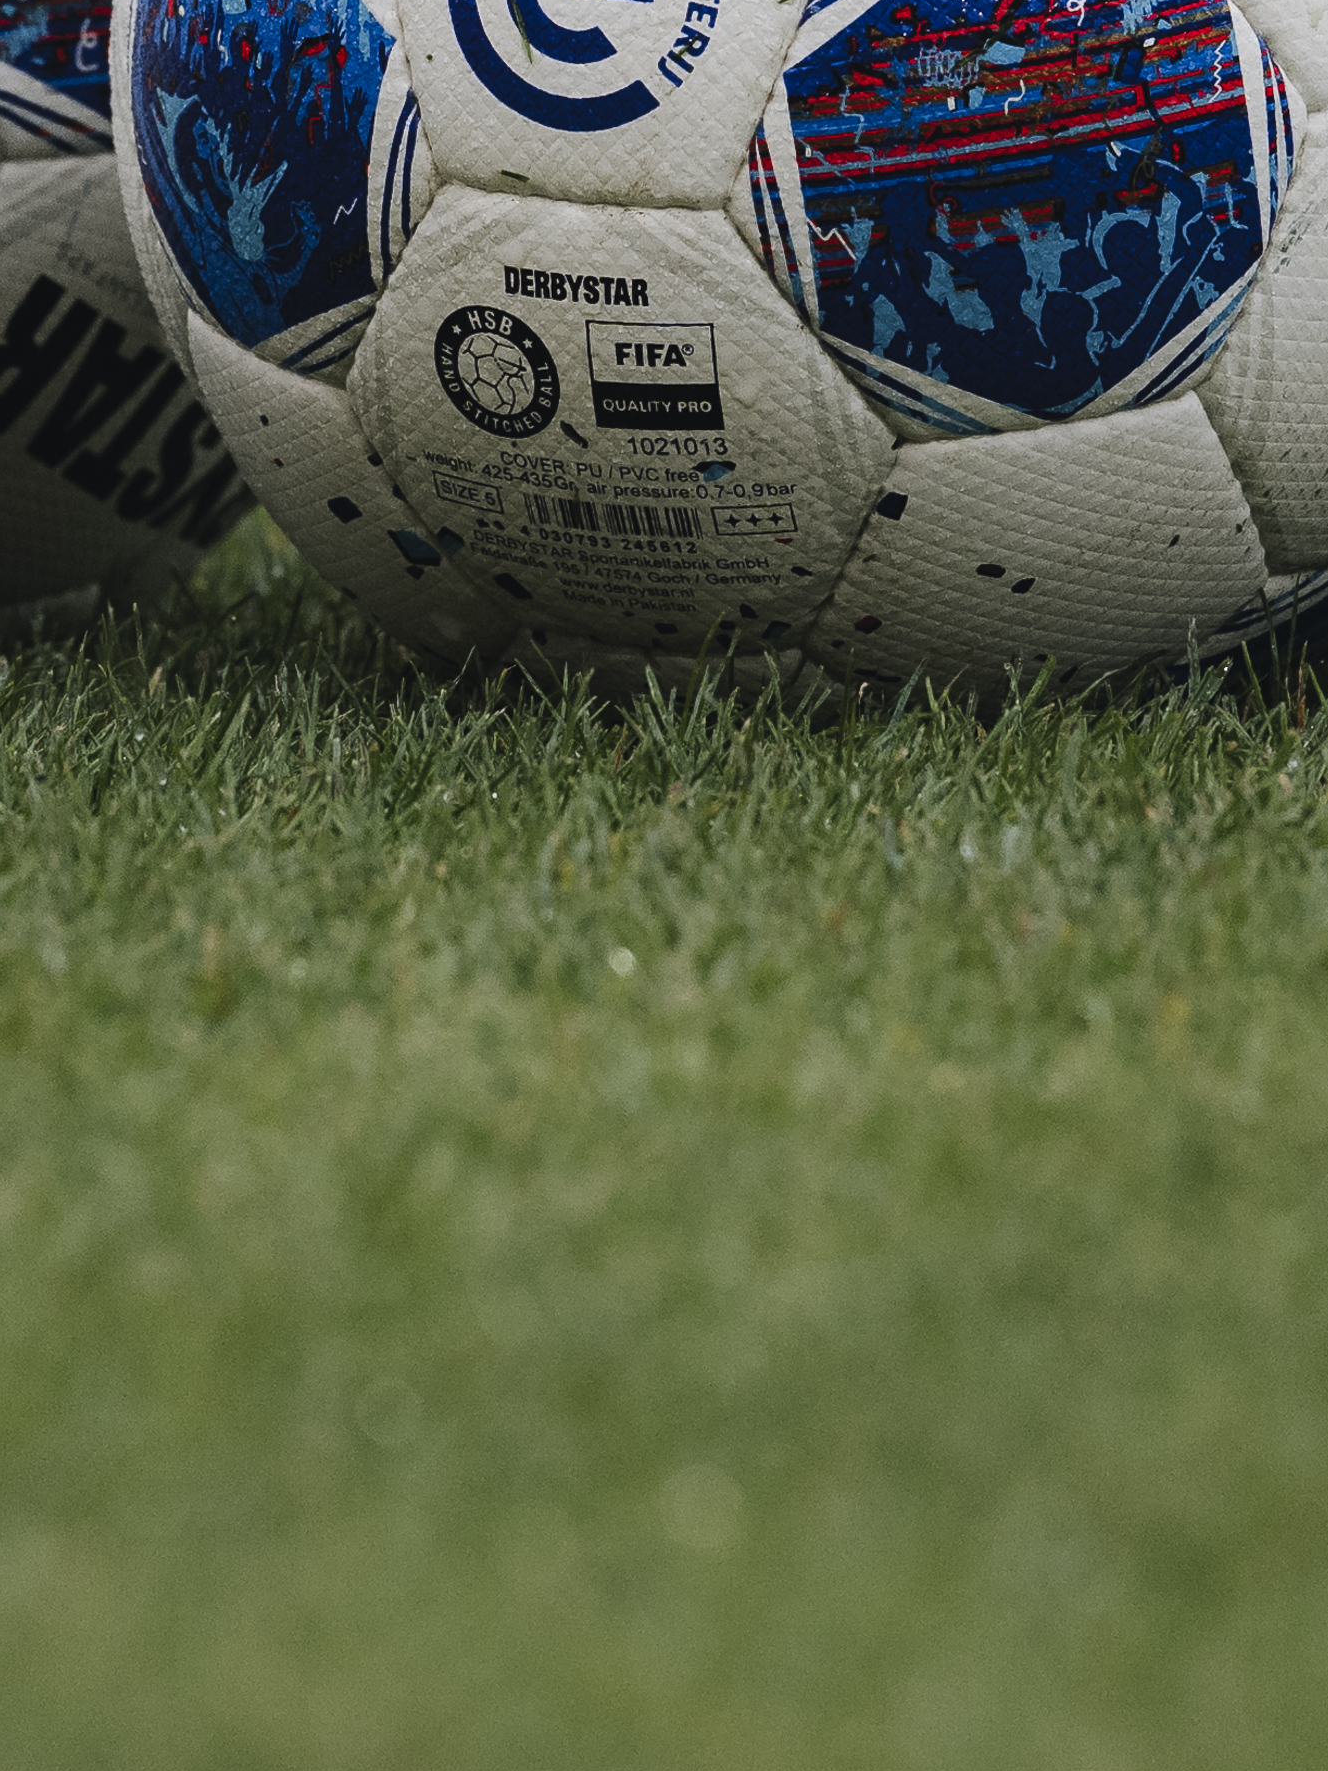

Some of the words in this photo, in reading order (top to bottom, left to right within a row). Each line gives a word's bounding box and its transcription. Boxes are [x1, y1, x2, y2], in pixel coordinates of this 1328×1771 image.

[504, 265, 650, 307] DERBYSTAR
[467, 310, 513, 336] HSB
[441, 342, 461, 392] HAND
[462, 400, 543, 433] STITCHED
[537, 362, 554, 408] BALL
[602, 399, 671, 413] QUALITY
[677, 400, 713, 413] PRO
[626, 436, 729, 456] 1021013
[500, 451, 571, 475] COVER:
[576, 461, 603, 478] PU
[608, 464, 613, 479] /
[619, 466, 661, 481] PVC
[664, 468, 700, 483] free
[440, 479, 482, 503] SIZE
[485, 491, 496, 506] 5
[586, 480, 608, 495] air
[473, 529, 574, 560] DERBYSTAR
[716, 557, 771, 570] GmbH
[539, 527, 612, 549] 030793
[621, 538, 698, 554] 245612
[553, 561, 581, 576] 195
[594, 567, 642, 582] 47574
[647, 571, 695, 585] Goch
[705, 572, 783, 586] Germany
[562, 589, 606, 606] Made
[628, 598, 697, 612] Pakistan
